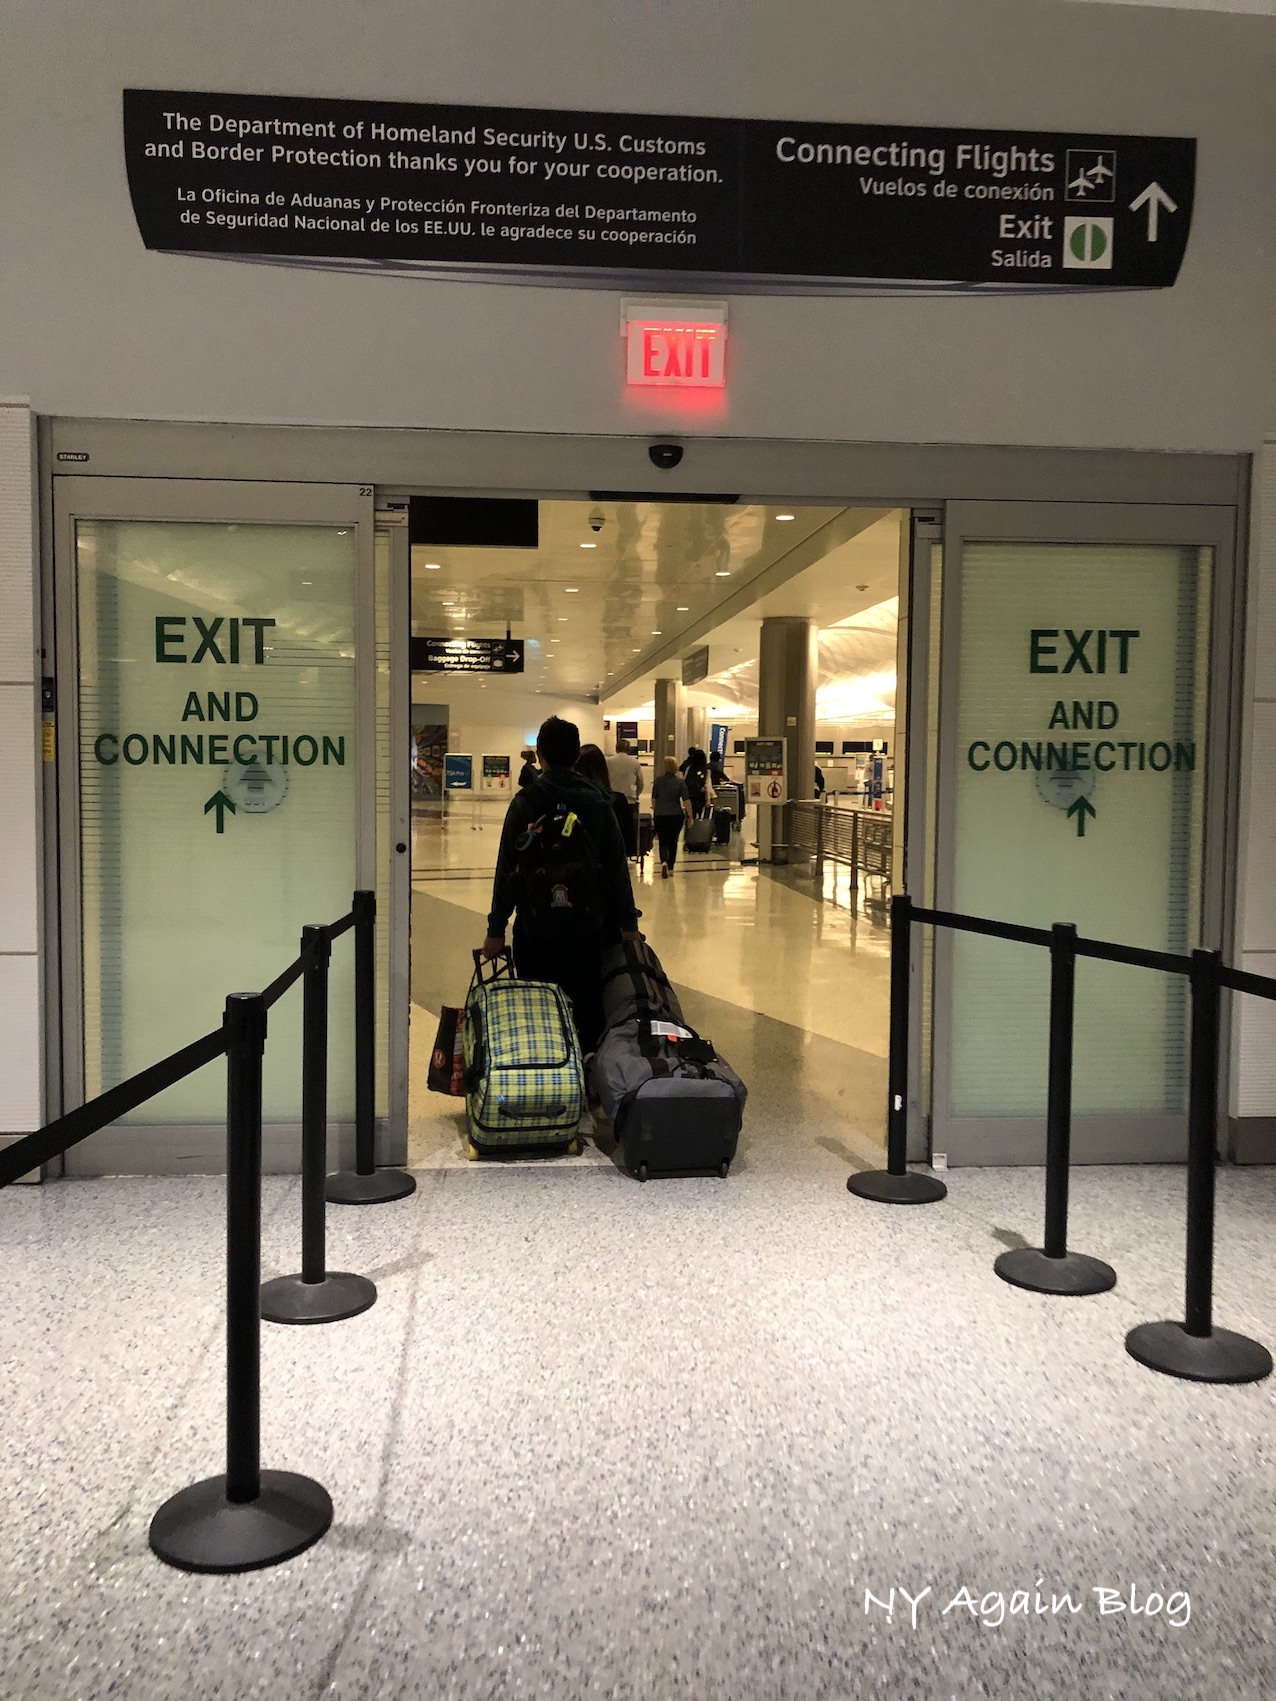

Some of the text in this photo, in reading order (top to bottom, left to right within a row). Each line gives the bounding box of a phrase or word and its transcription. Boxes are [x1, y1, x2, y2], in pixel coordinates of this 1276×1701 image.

[162, 112, 706, 156] The Department of Homeland Security U.S. Customs
[144, 139, 724, 184] and Border Protection thanks you for your cooperation.
[776, 137, 1055, 178] Connecting Flights
[177, 187, 697, 224] La Oficina de Aduanas y Protección Fronteriza del Departamento
[859, 176, 1054, 201] Vuelos de conexión
[180, 209, 697, 246] de Seguridad Nacional de los EE.UU. le agradece su cooperación
[999, 214, 1053, 240] Exit
[991, 249, 1052, 268] Salida
[644, 328, 717, 378] EXIT
[359, 488, 372, 496] 22
[155, 616, 276, 665] EXIT
[1029, 629, 1140, 674] EXIT
[182, 691, 259, 722] AND
[1048, 700, 1120, 730] AND
[94, 734, 346, 766] CONNECTION
[967, 740, 1197, 772] CONNECTION
